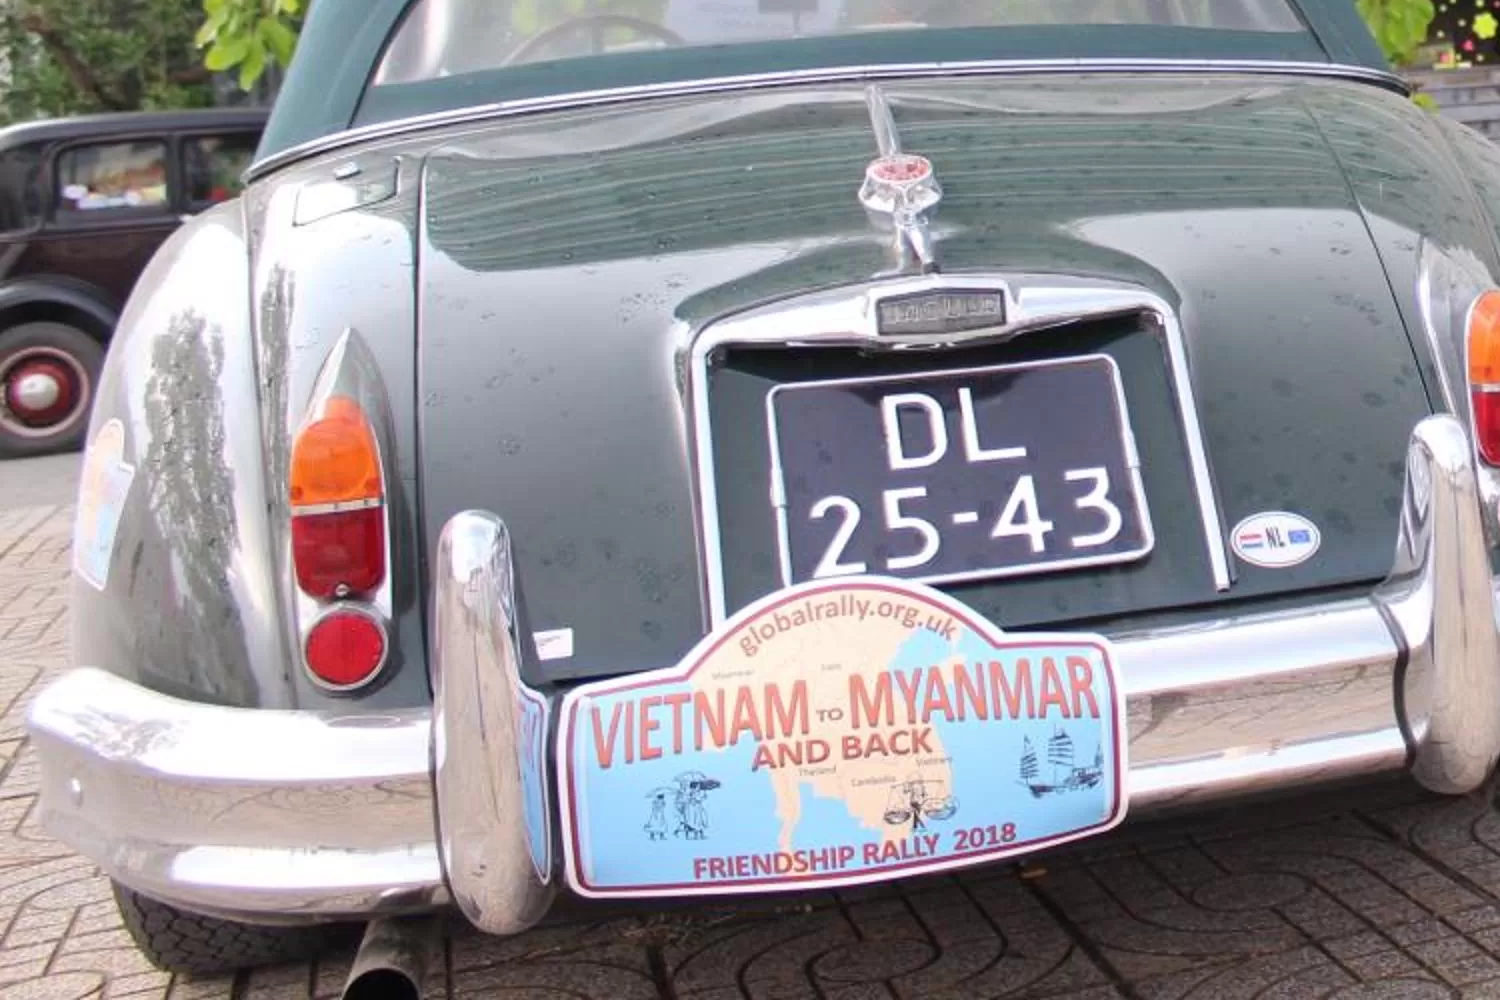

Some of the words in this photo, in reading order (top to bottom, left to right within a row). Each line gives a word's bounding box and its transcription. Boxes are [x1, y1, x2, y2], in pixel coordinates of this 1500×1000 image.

[882, 387, 1026, 470] DL
[809, 466, 1122, 578] 25-43
[739, 594, 957, 658] globalrally.org.uk
[590, 679, 809, 769] VIETNAM
[816, 708, 844, 724] TO
[848, 656, 1101, 729] MYANMAR
[752, 738, 832, 772] AND
[841, 728, 934, 761] BACK
[693, 845, 855, 879] FRIENDSHIP
[863, 833, 940, 865] RALLY
[953, 822, 1017, 851] 2018
